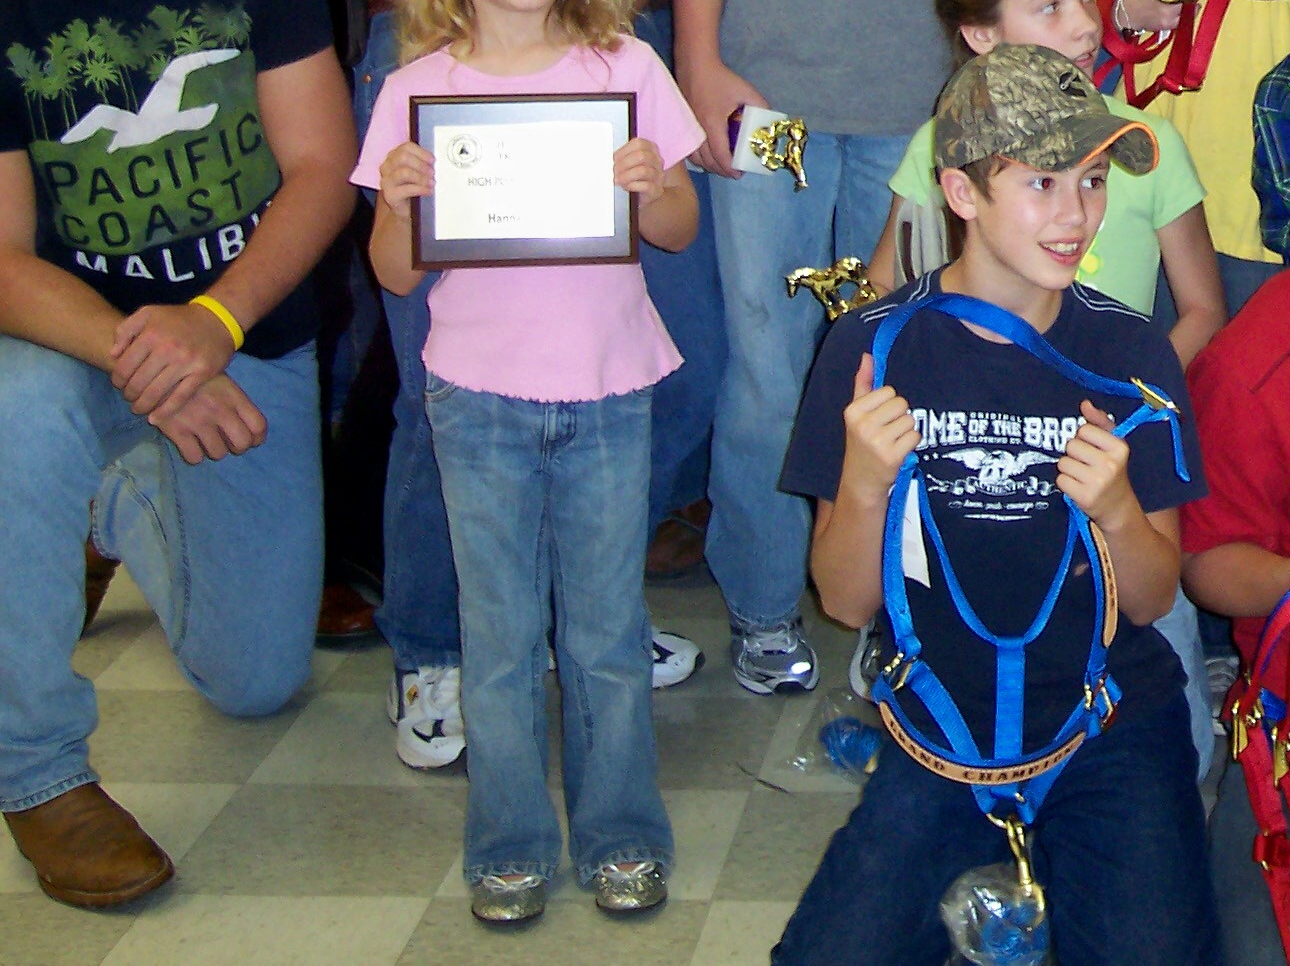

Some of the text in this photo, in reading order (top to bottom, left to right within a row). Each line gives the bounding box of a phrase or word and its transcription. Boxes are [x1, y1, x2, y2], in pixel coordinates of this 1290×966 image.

[44, 112, 264, 206] PACIFIC
[60, 169, 245, 248] COAST
[75, 200, 273, 283] MALIB
[908, 408, 1115, 454] OME OF THE BRA
[962, 747, 1072, 782] CHAMPION
